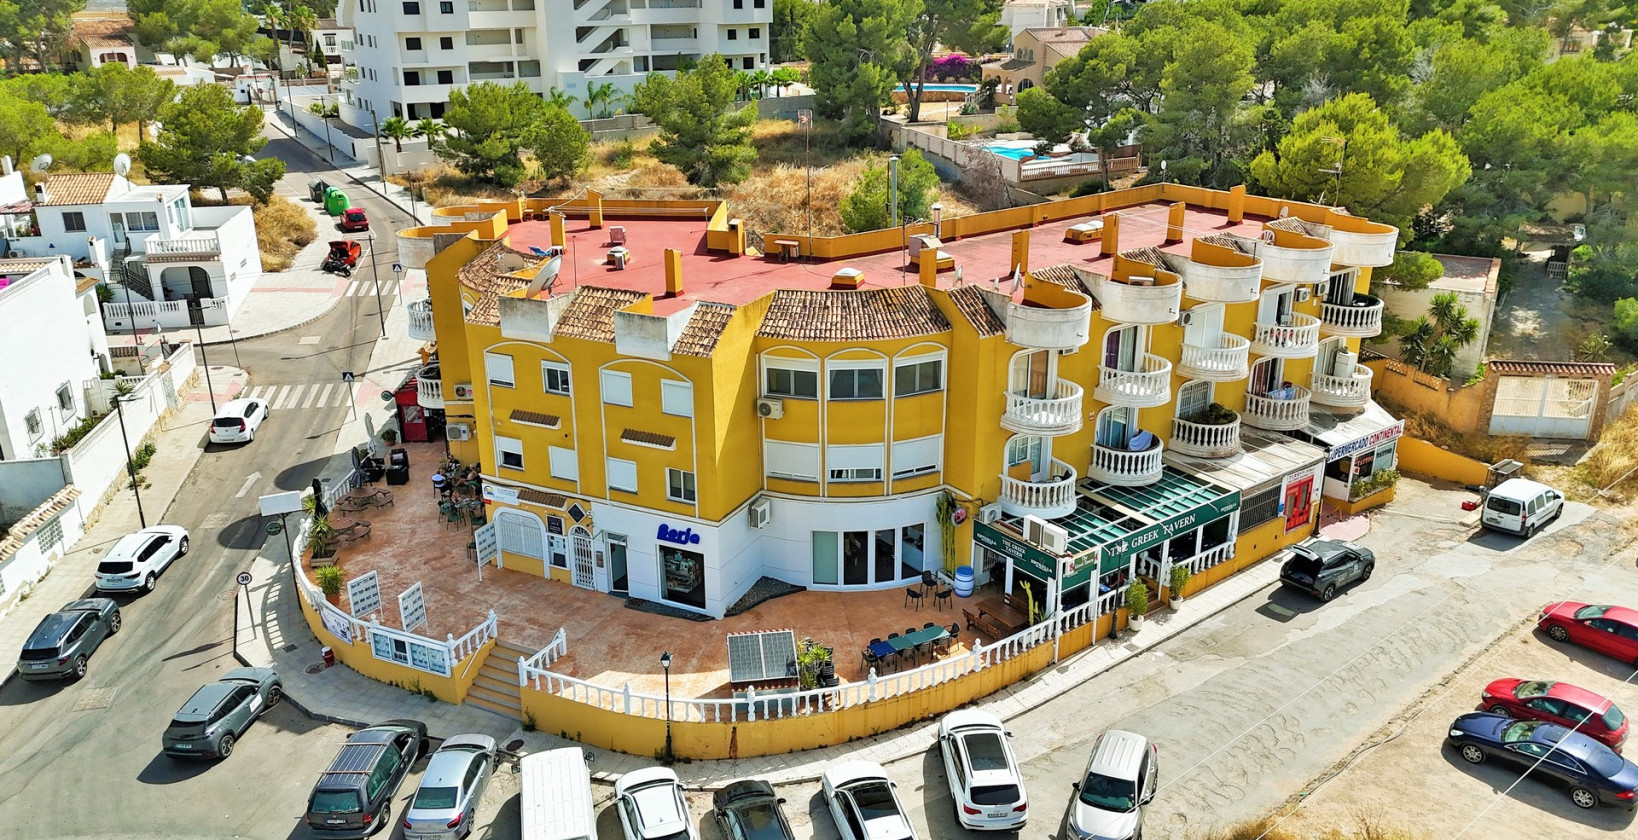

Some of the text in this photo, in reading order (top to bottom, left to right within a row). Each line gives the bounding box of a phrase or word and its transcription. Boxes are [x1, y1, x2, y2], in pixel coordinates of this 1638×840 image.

[1369, 424, 1402, 446] CONTINENTAL
[1131, 529, 1159, 548] GREEK
[1163, 513, 1196, 535] TAVERN
